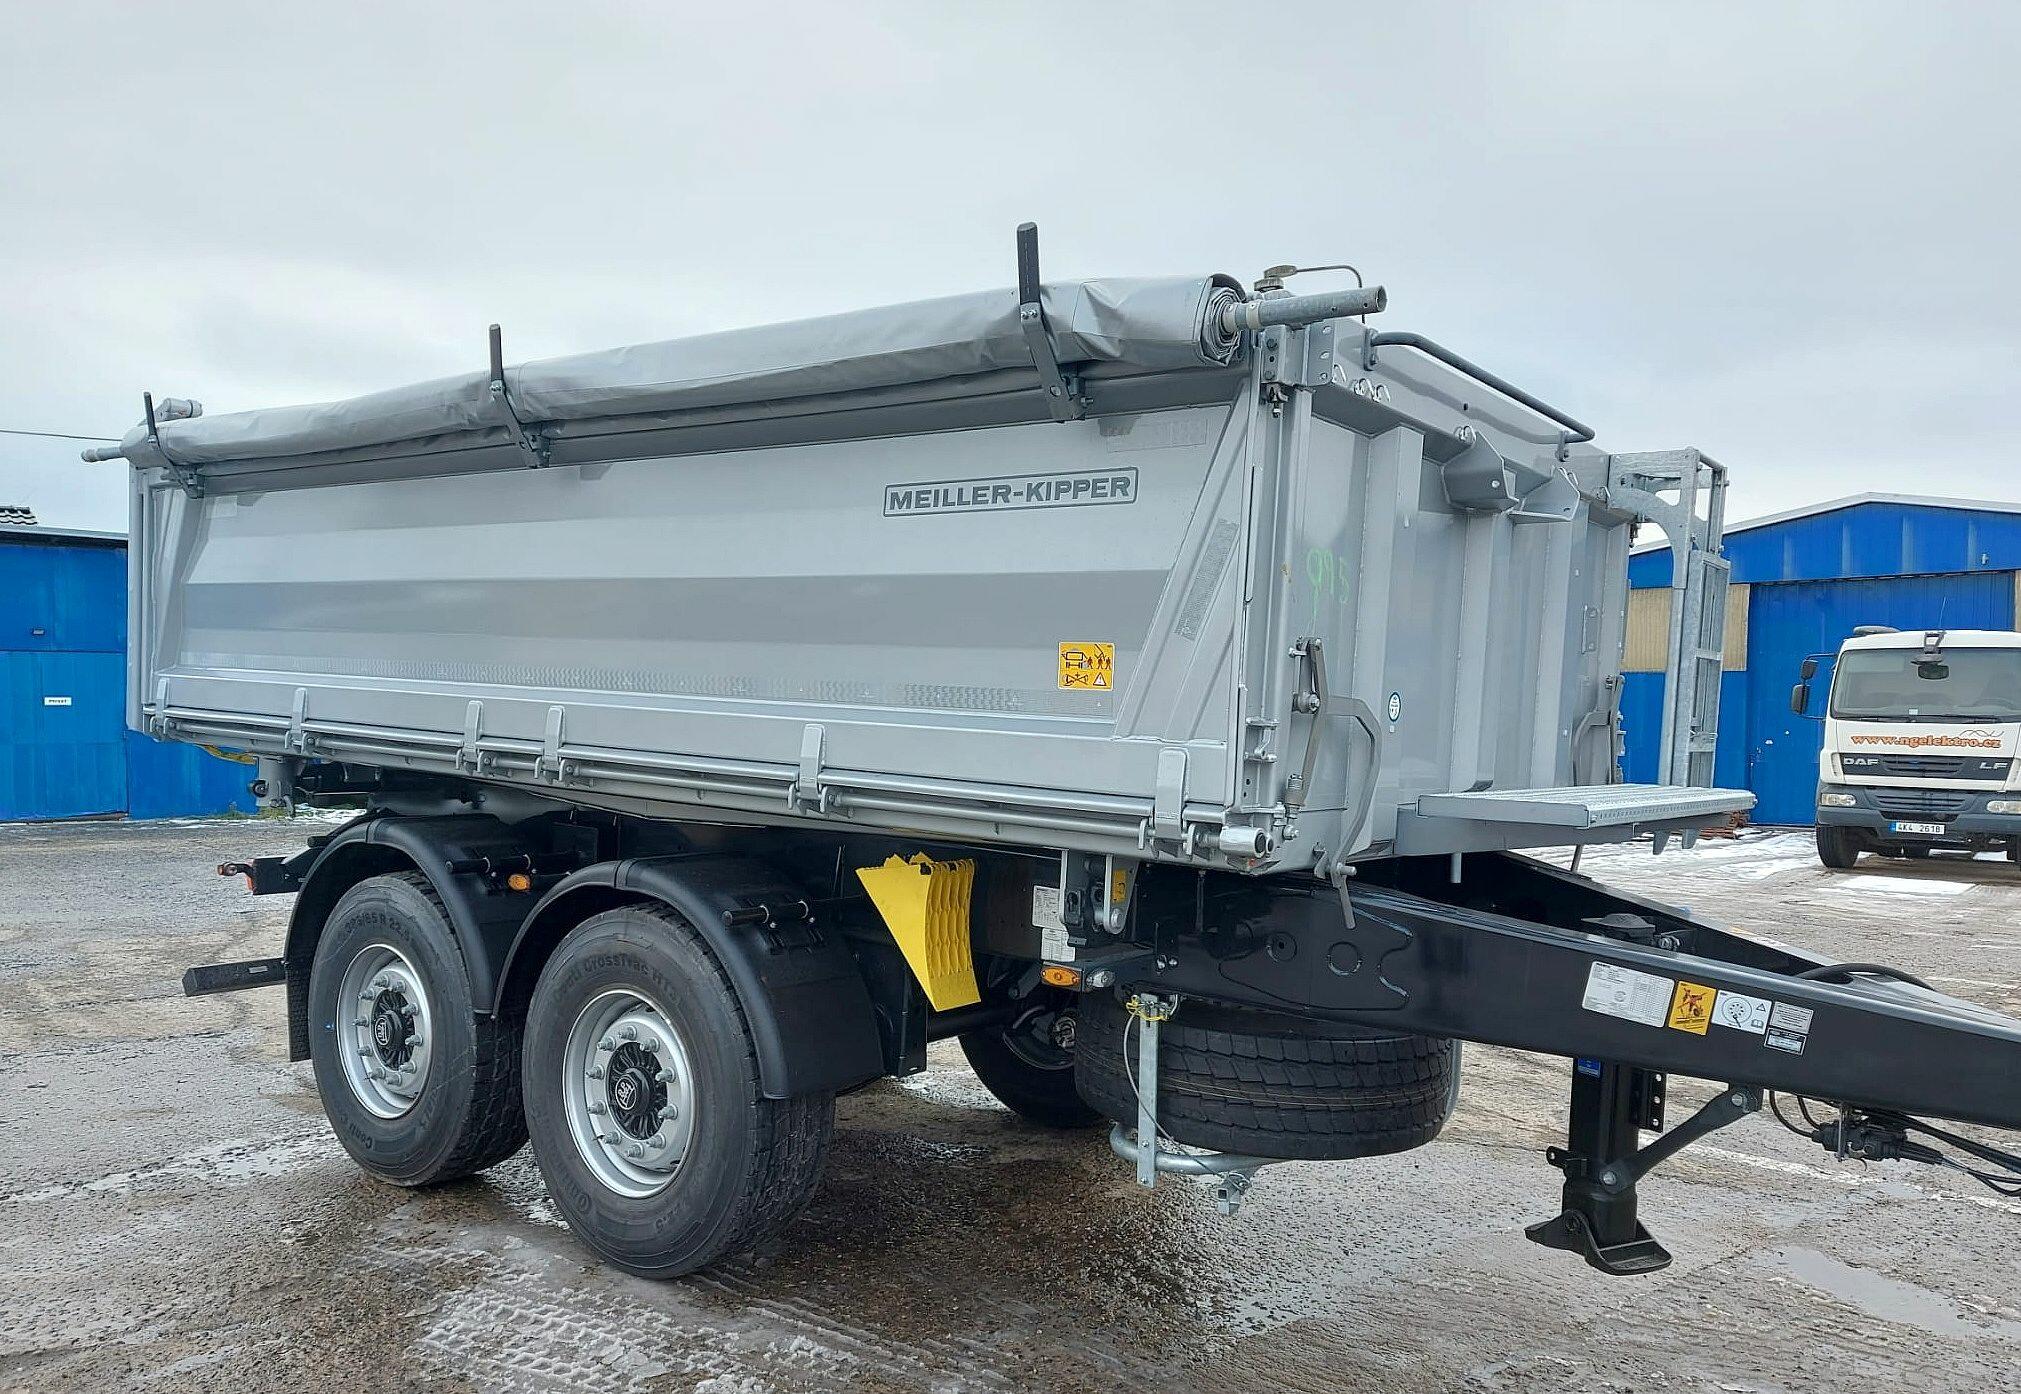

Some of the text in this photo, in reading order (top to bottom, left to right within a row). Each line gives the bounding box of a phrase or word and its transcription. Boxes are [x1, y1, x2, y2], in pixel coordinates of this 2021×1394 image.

[889, 476, 1131, 510] MEILLER-KIPPER
[1851, 735, 2002, 748] www.ngelektro.cz
[1843, 758, 1879, 766] DAF
